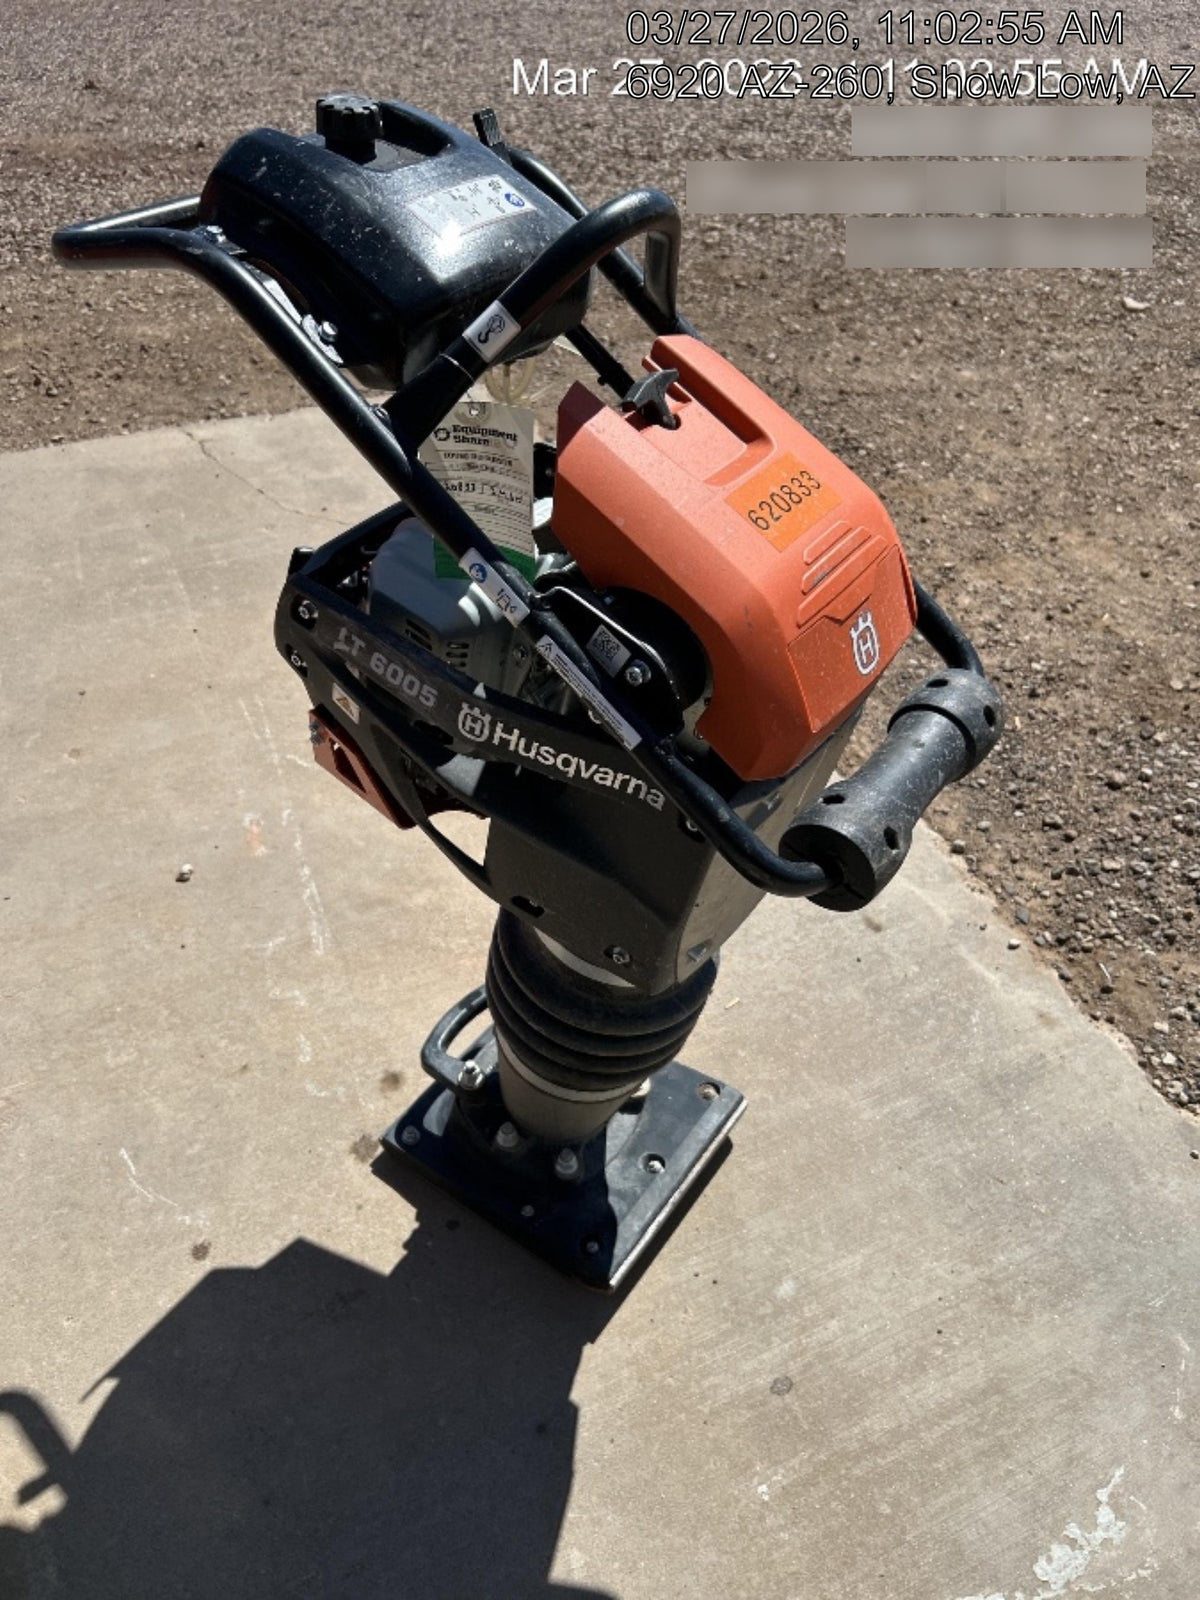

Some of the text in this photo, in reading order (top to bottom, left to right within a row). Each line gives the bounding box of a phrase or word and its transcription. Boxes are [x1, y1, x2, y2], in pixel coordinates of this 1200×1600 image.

[747, 470, 822, 531] 620833
[333, 627, 438, 724] LT 6005
[492, 721, 666, 812] Husqvarna
